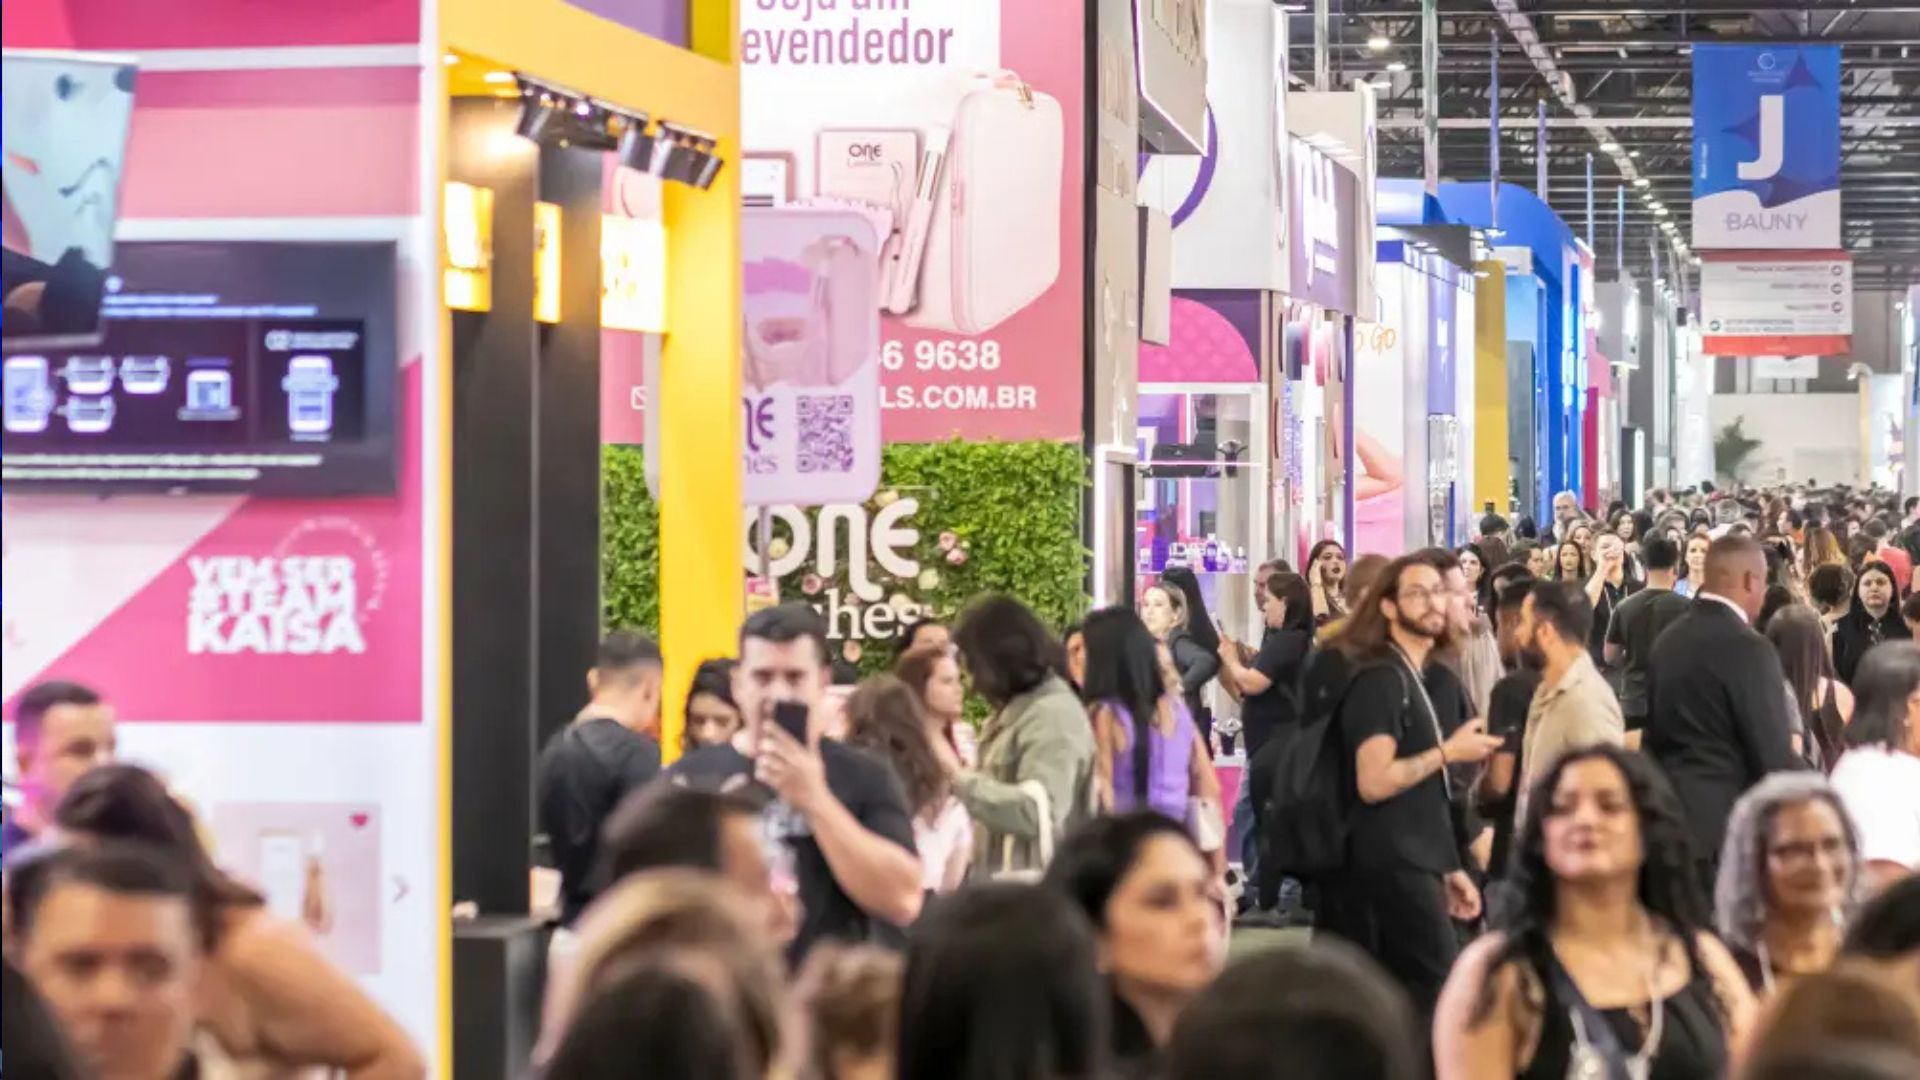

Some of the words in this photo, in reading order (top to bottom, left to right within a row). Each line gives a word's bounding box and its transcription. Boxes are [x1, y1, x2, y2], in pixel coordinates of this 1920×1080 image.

[741, 17, 953, 64] evendedor
[1736, 94, 1784, 180] J
[1725, 211, 1808, 232] BAUNY
[879, 340, 904, 370] 6
[915, 340, 1001, 370] 9638
[880, 385, 1037, 409] LS.COM.BR
[187, 609, 364, 653] KAISA
